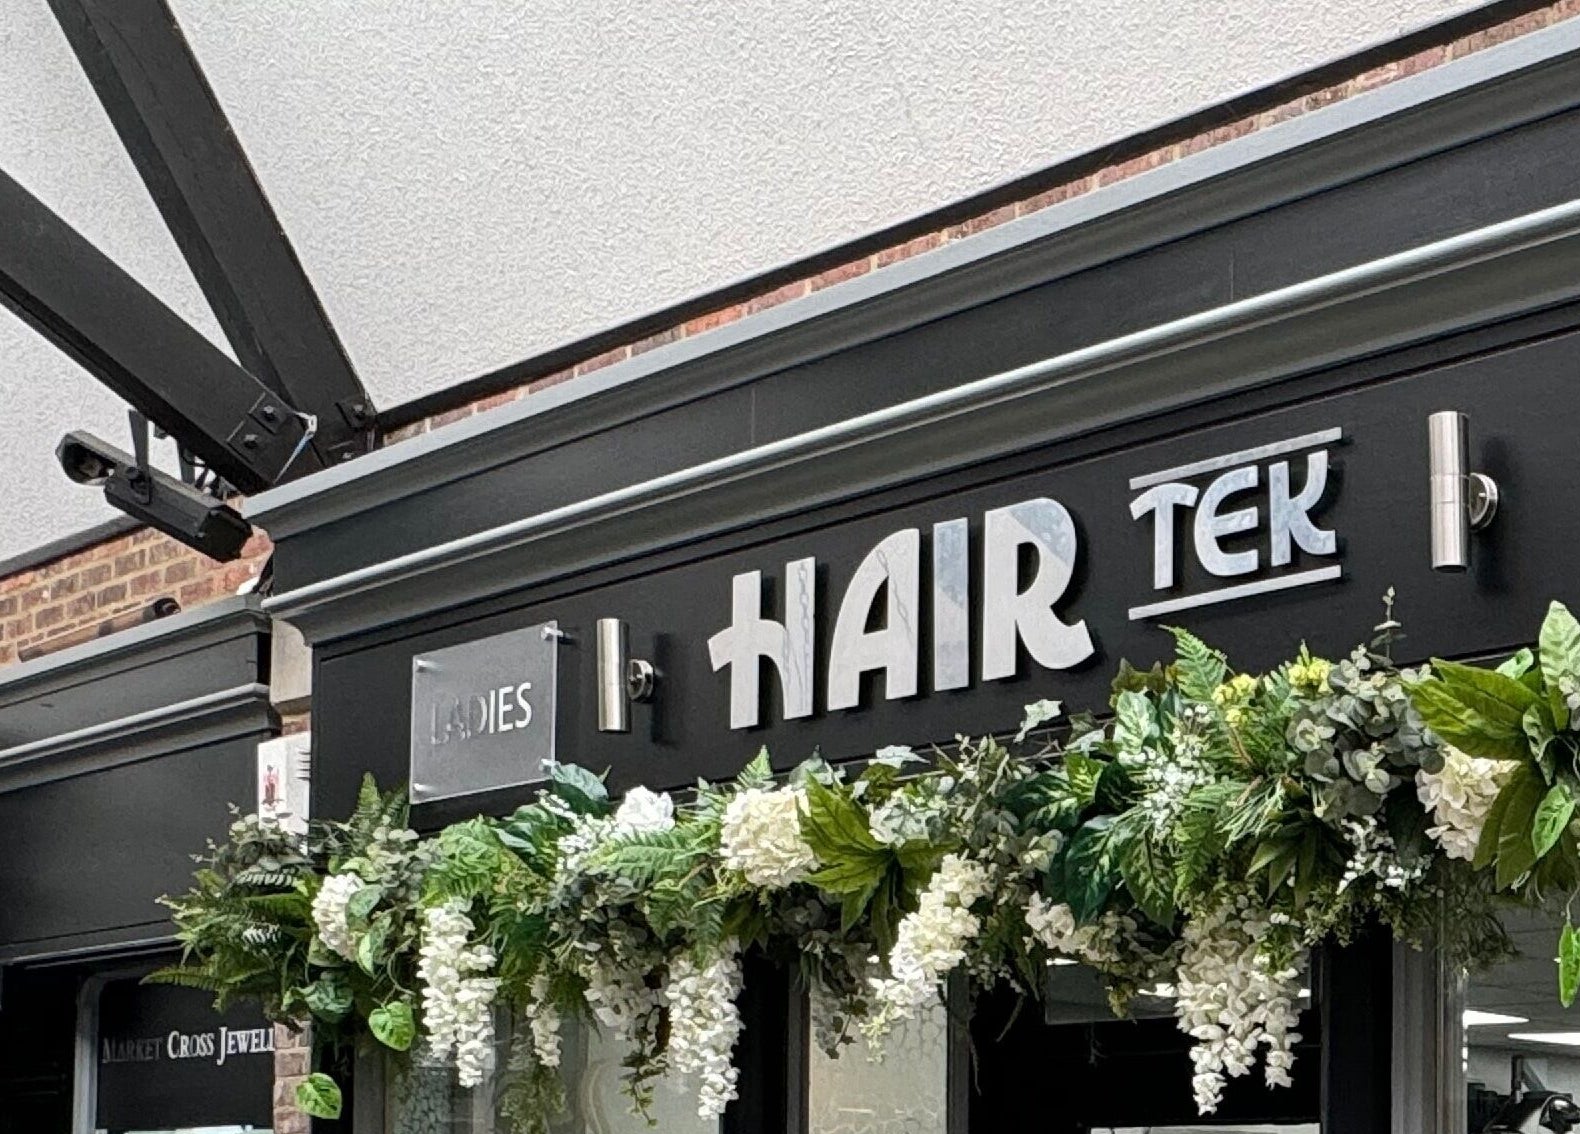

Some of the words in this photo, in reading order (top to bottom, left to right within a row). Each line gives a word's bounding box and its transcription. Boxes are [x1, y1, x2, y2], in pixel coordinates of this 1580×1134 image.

[707, 497, 1095, 730] HAIR
[1129, 450, 1336, 589] TEK
[431, 682, 532, 745] LADIES
[167, 1030, 215, 1060] CROSS
